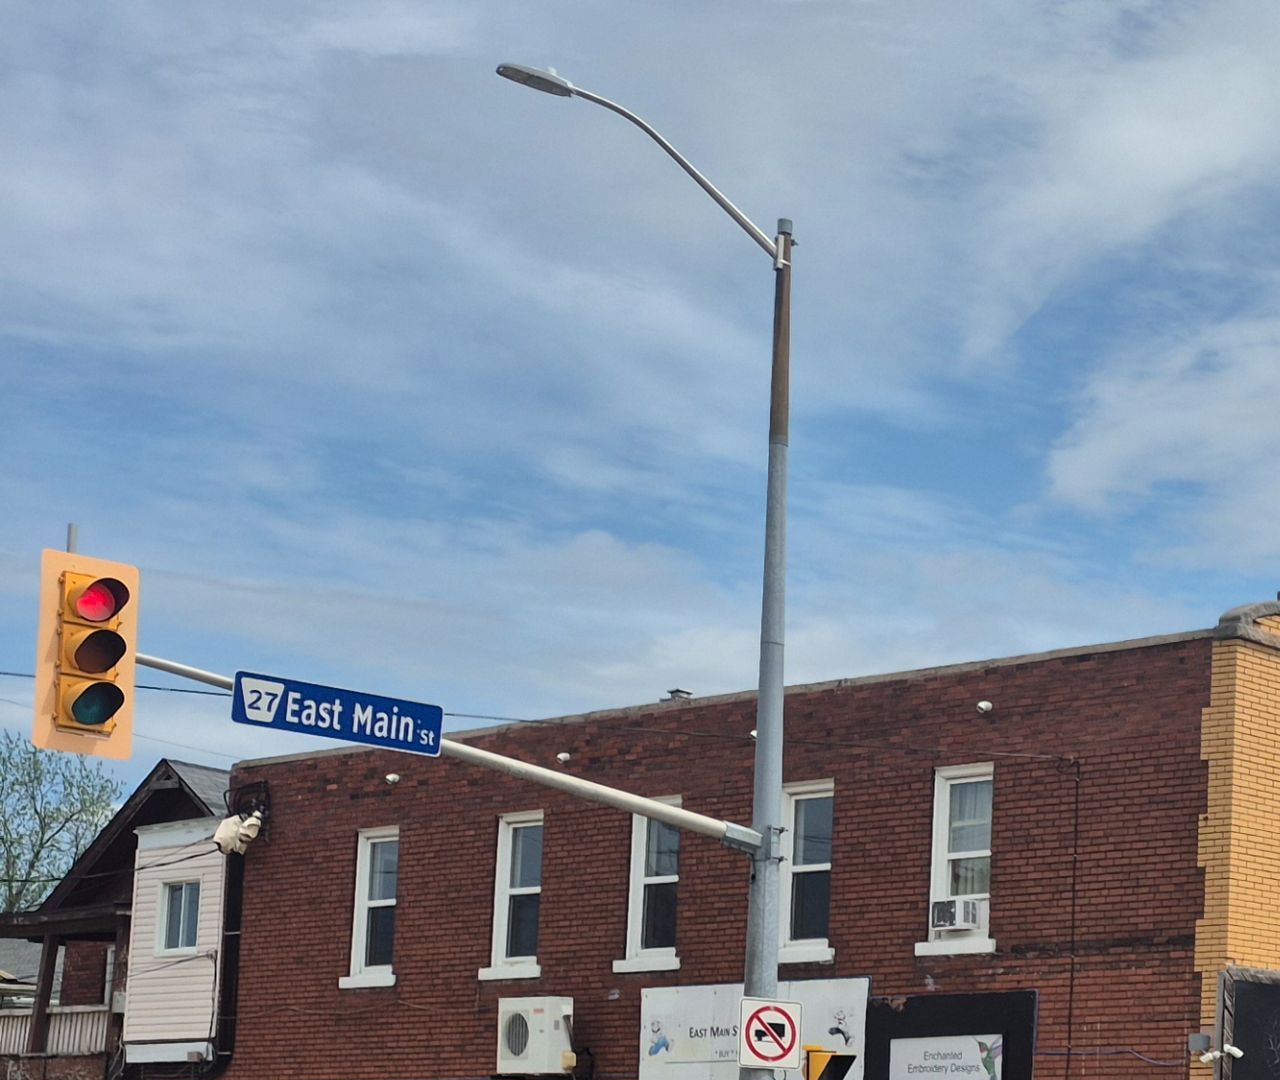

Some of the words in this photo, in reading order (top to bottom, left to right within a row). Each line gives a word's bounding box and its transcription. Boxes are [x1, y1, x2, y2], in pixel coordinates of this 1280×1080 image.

[247, 689, 279, 713] 27
[285, 691, 343, 731] East
[352, 702, 414, 743] Main
[689, 1026, 707, 1038] EAST
[710, 1025, 730, 1037] MAIN
[923, 1051, 963, 1061] Enchanted
[907, 1063, 949, 1075] Embroidery
[950, 1063, 980, 1075] Designs
